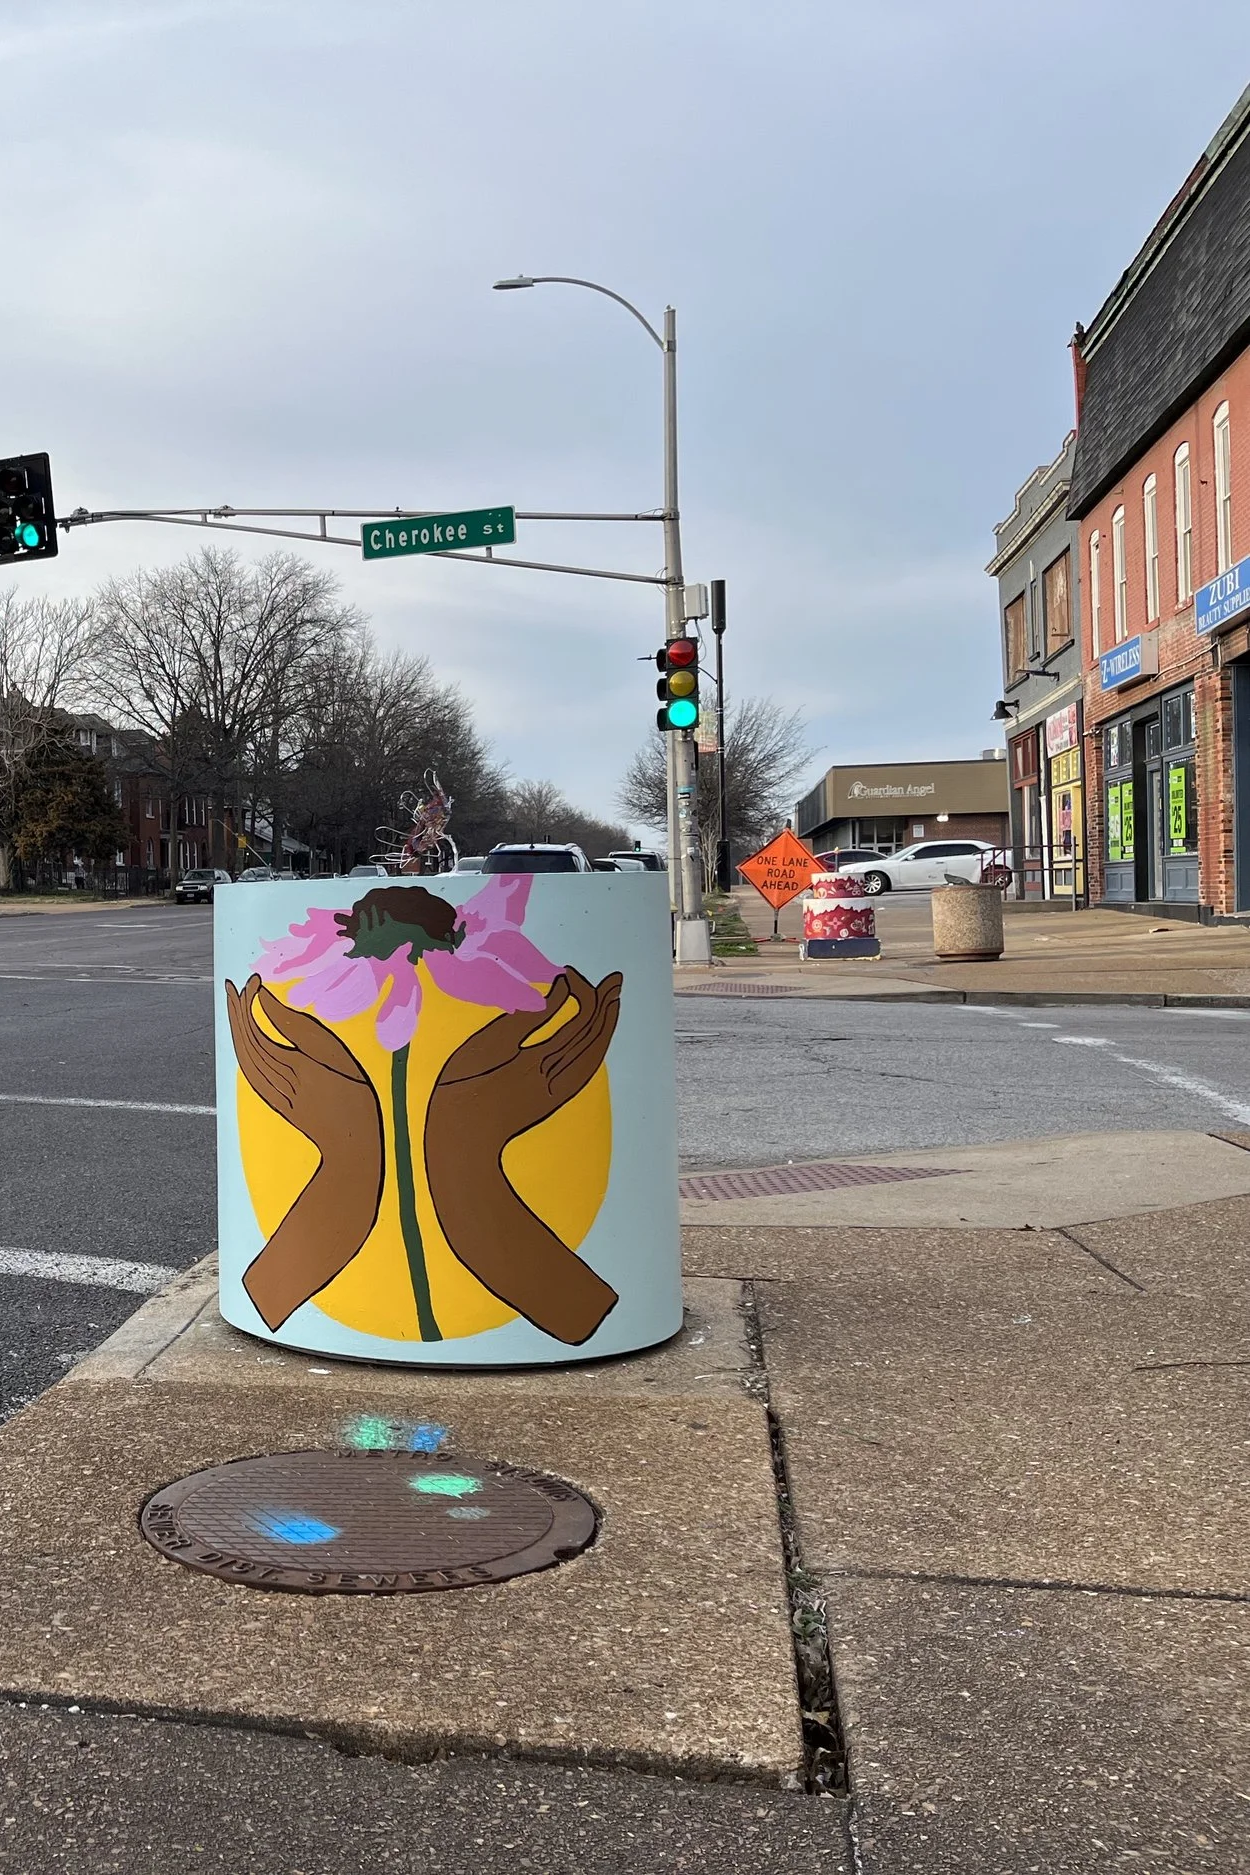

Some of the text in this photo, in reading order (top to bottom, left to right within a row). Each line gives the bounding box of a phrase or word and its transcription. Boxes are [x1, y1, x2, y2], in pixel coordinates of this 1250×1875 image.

[370, 523, 468, 551] Cherokee
[1209, 567, 1240, 607] ZUBI
[1198, 586, 1250, 631] BEAUTY SUPPLIE
[859, 783, 935, 796] Guardian Angel
[757, 856, 809, 867] ONE LANE
[767, 868, 795, 879] ROAD
[761, 880, 799, 891] AHEAD
[337, 1448, 454, 1462] METRO
[148, 1503, 193, 1550] SEWER
[306, 1566, 493, 1588] SEWERS
